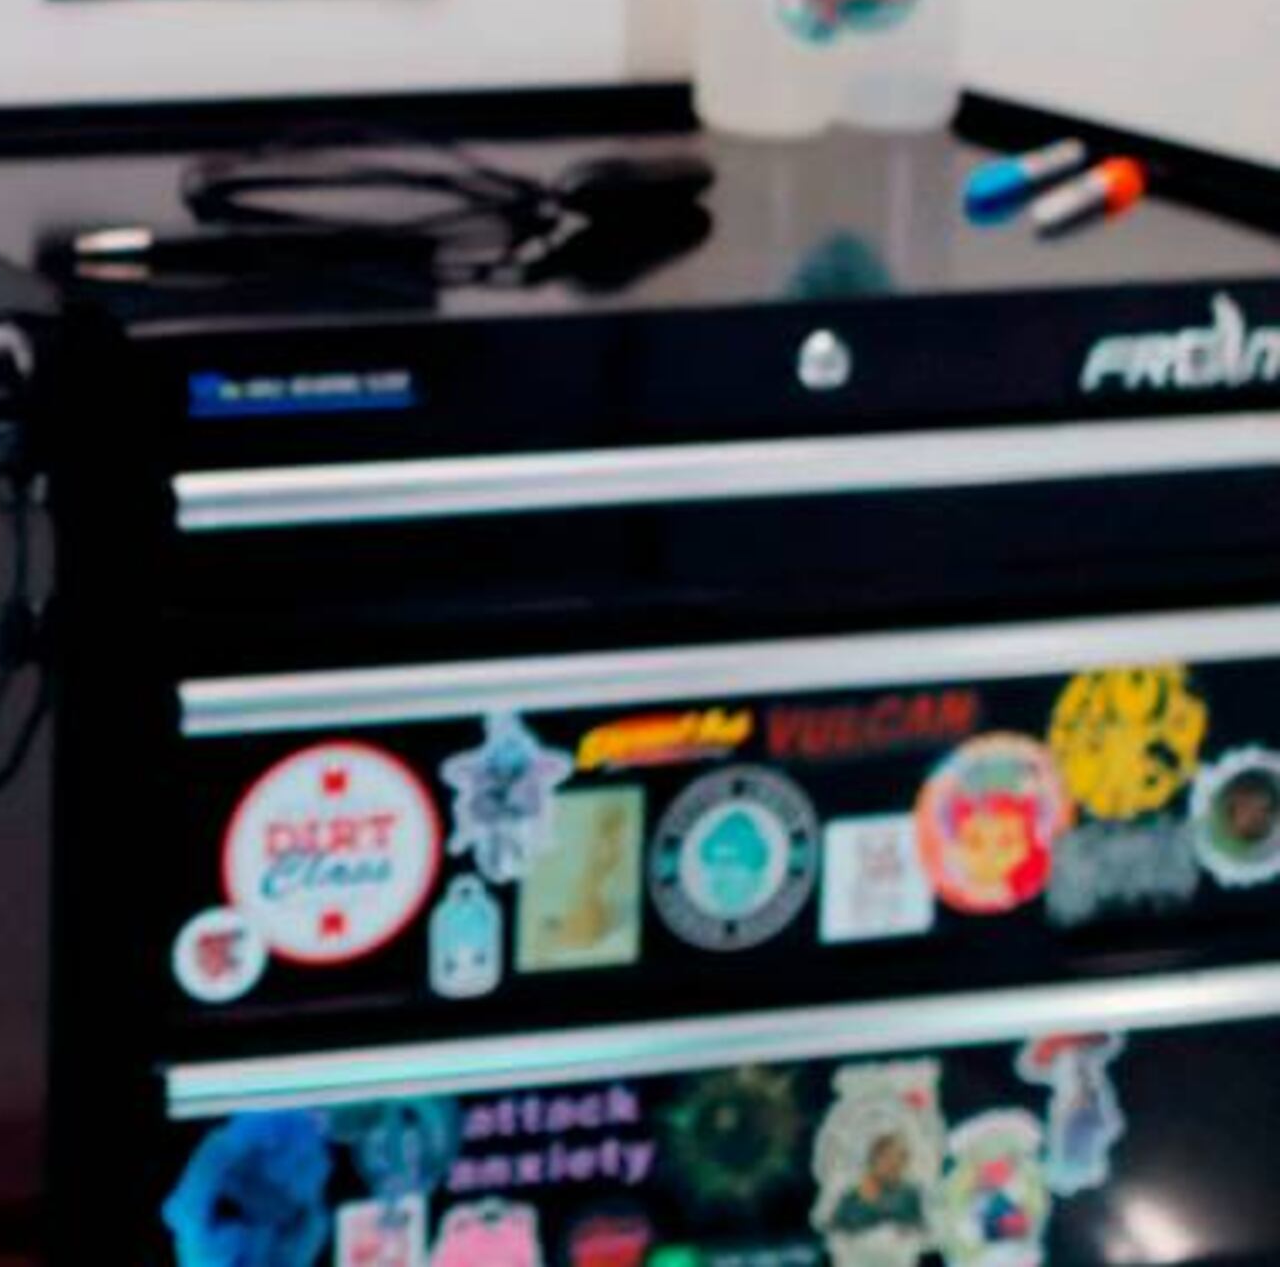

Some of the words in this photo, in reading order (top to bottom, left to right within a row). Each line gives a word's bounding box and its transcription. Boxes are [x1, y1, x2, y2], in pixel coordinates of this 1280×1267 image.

[768, 689, 978, 756] VULCAN
[266, 811, 397, 858] DIRT
[464, 1086, 638, 1138] attack
[448, 1139, 655, 1192] anxiety
